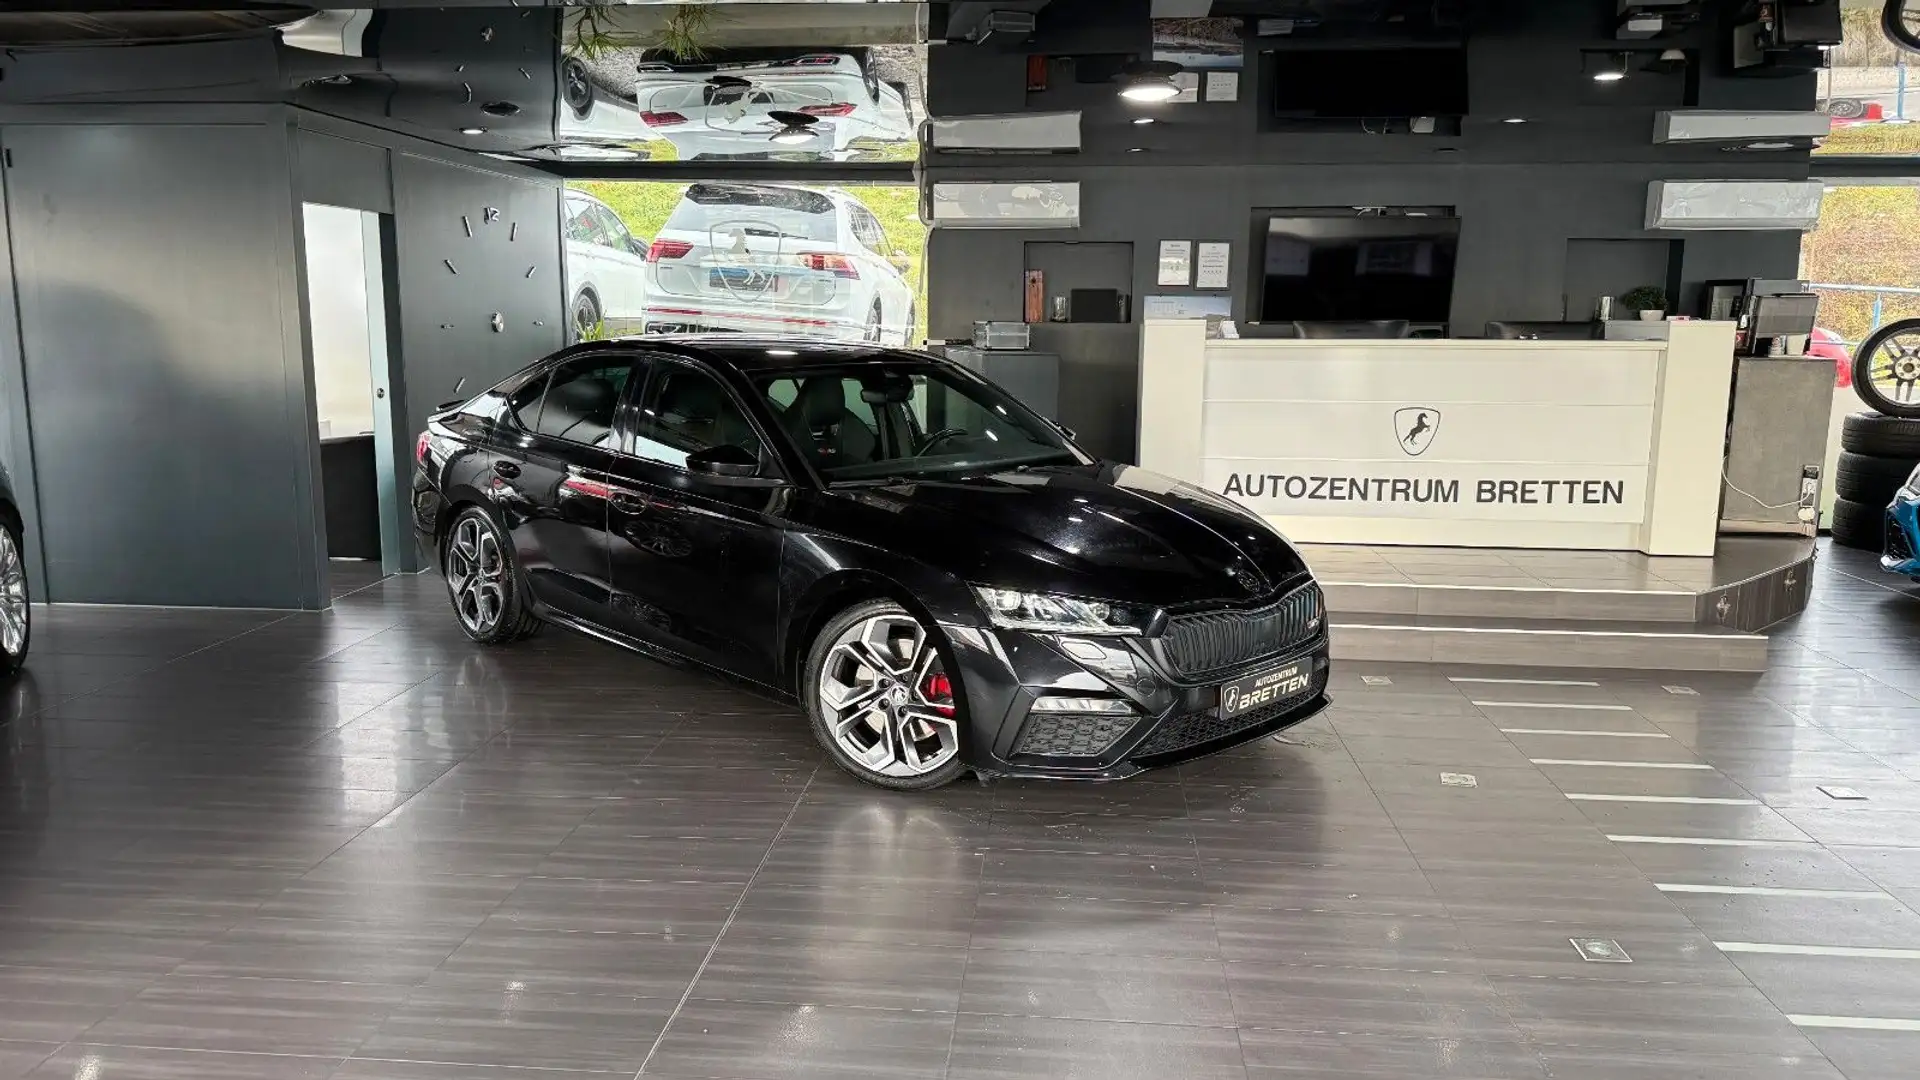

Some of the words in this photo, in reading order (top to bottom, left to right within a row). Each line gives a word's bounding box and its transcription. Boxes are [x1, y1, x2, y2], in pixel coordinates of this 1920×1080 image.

[1223, 473, 1459, 502] AUTOZENTRUM
[1476, 480, 1623, 504] BRETTEN
[1239, 673, 1309, 710] BRETTEN
[1255, 666, 1298, 687] AUTOZENTRUM
